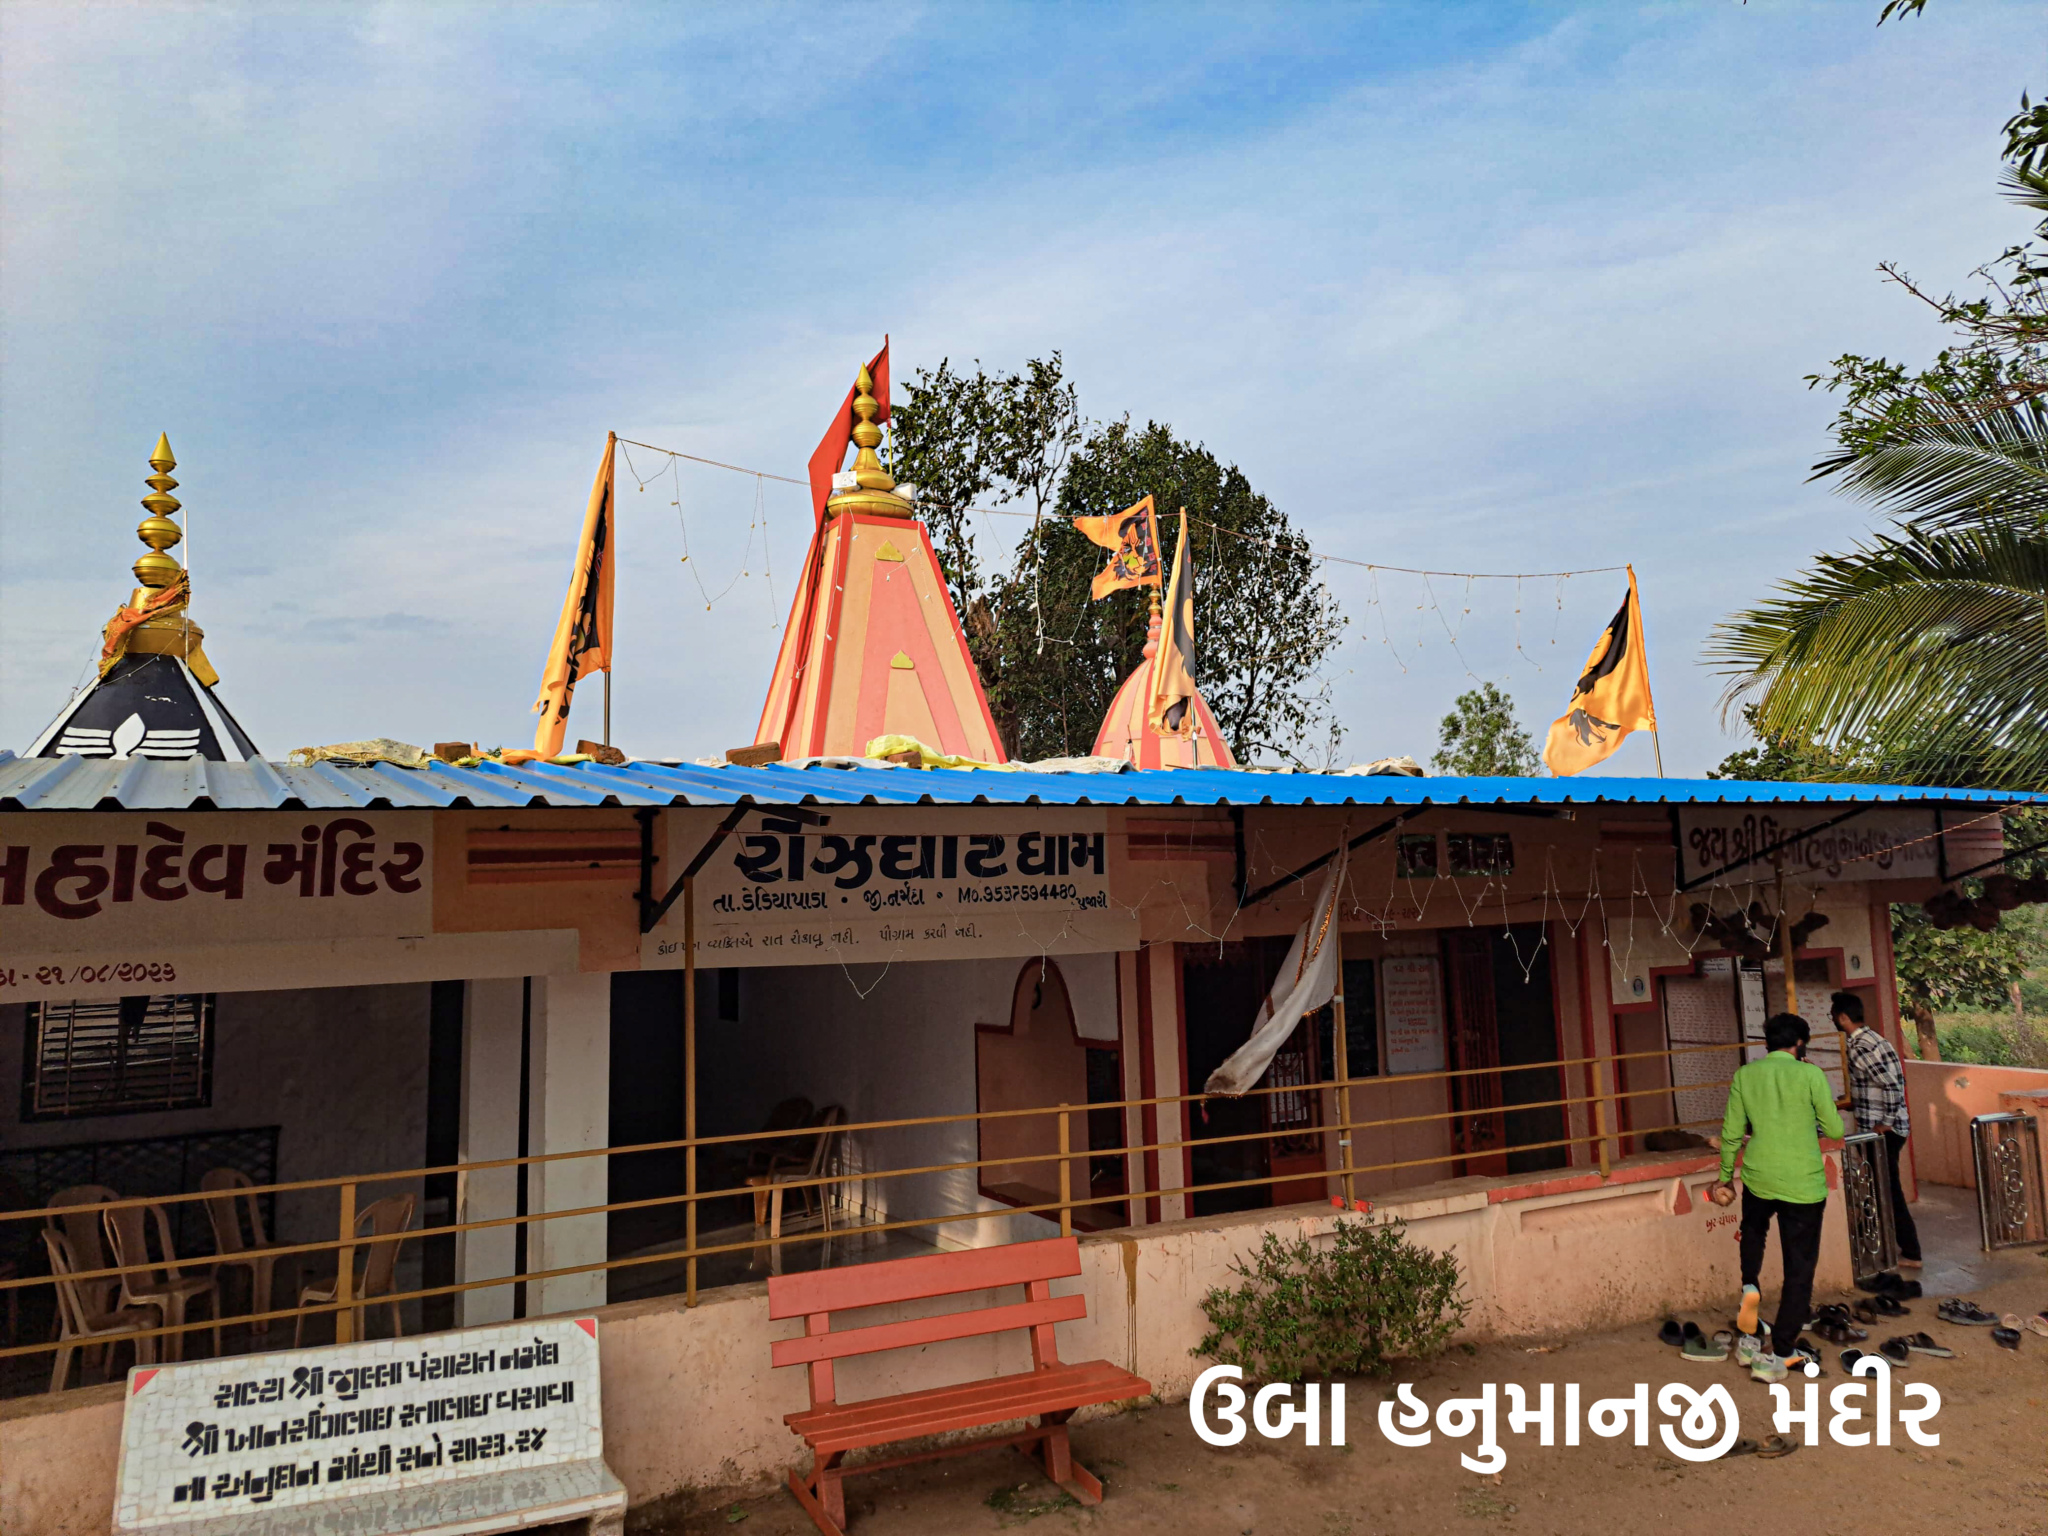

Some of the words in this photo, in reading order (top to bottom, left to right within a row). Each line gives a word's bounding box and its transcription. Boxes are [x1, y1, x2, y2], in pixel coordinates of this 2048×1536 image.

[263, 818, 425, 897] મંદિર
[1689, 826, 1728, 868] જય
[762, 933, 783, 947] રાત
[288, 1366, 323, 1400] શ્રી
[407, 1350, 496, 1383] પંચાયત
[499, 1337, 559, 1370] નર્મદા
[181, 1420, 218, 1458] શ્રી
[497, 1380, 574, 1413] વસાવા
[173, 1475, 206, 1503] ના
[212, 1459, 320, 1503] અનુદાન
[328, 1444, 392, 1482] માંથી
[395, 1431, 442, 1470] સને
